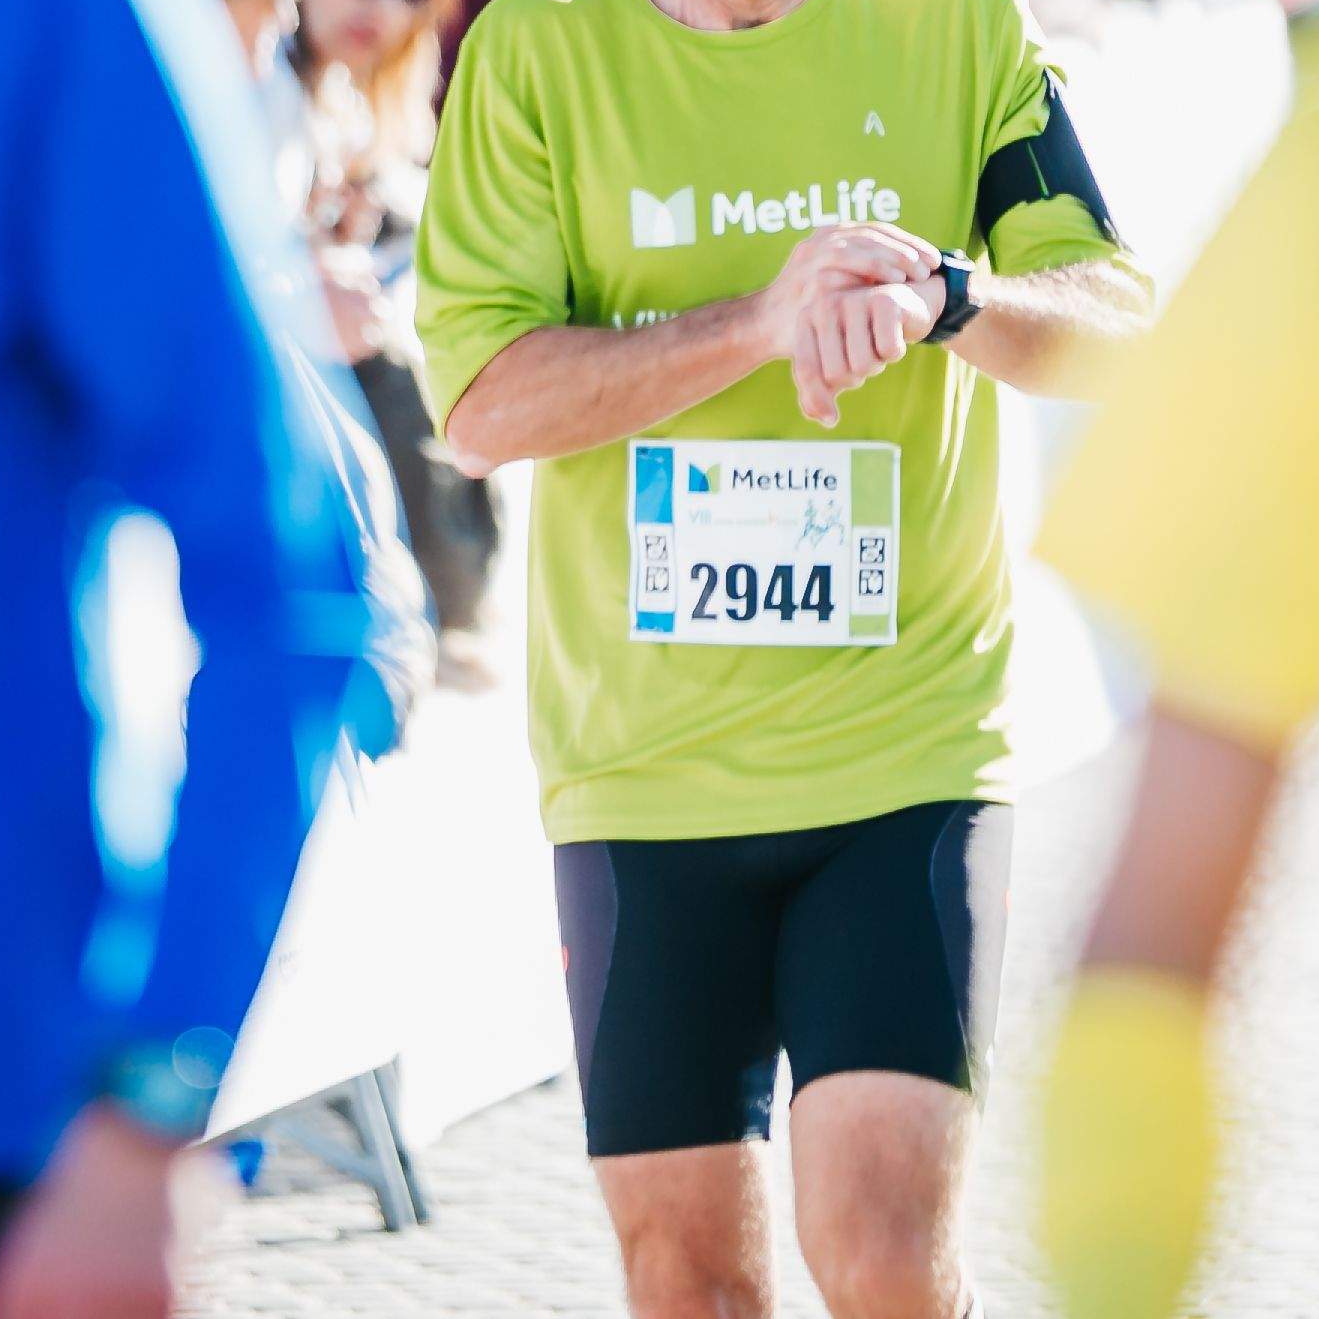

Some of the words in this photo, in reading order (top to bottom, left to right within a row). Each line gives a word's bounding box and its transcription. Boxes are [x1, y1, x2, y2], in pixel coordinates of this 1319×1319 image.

[711, 177, 901, 236] MetLife
[732, 466, 838, 491] MetLife
[690, 562, 836, 622] 2944
